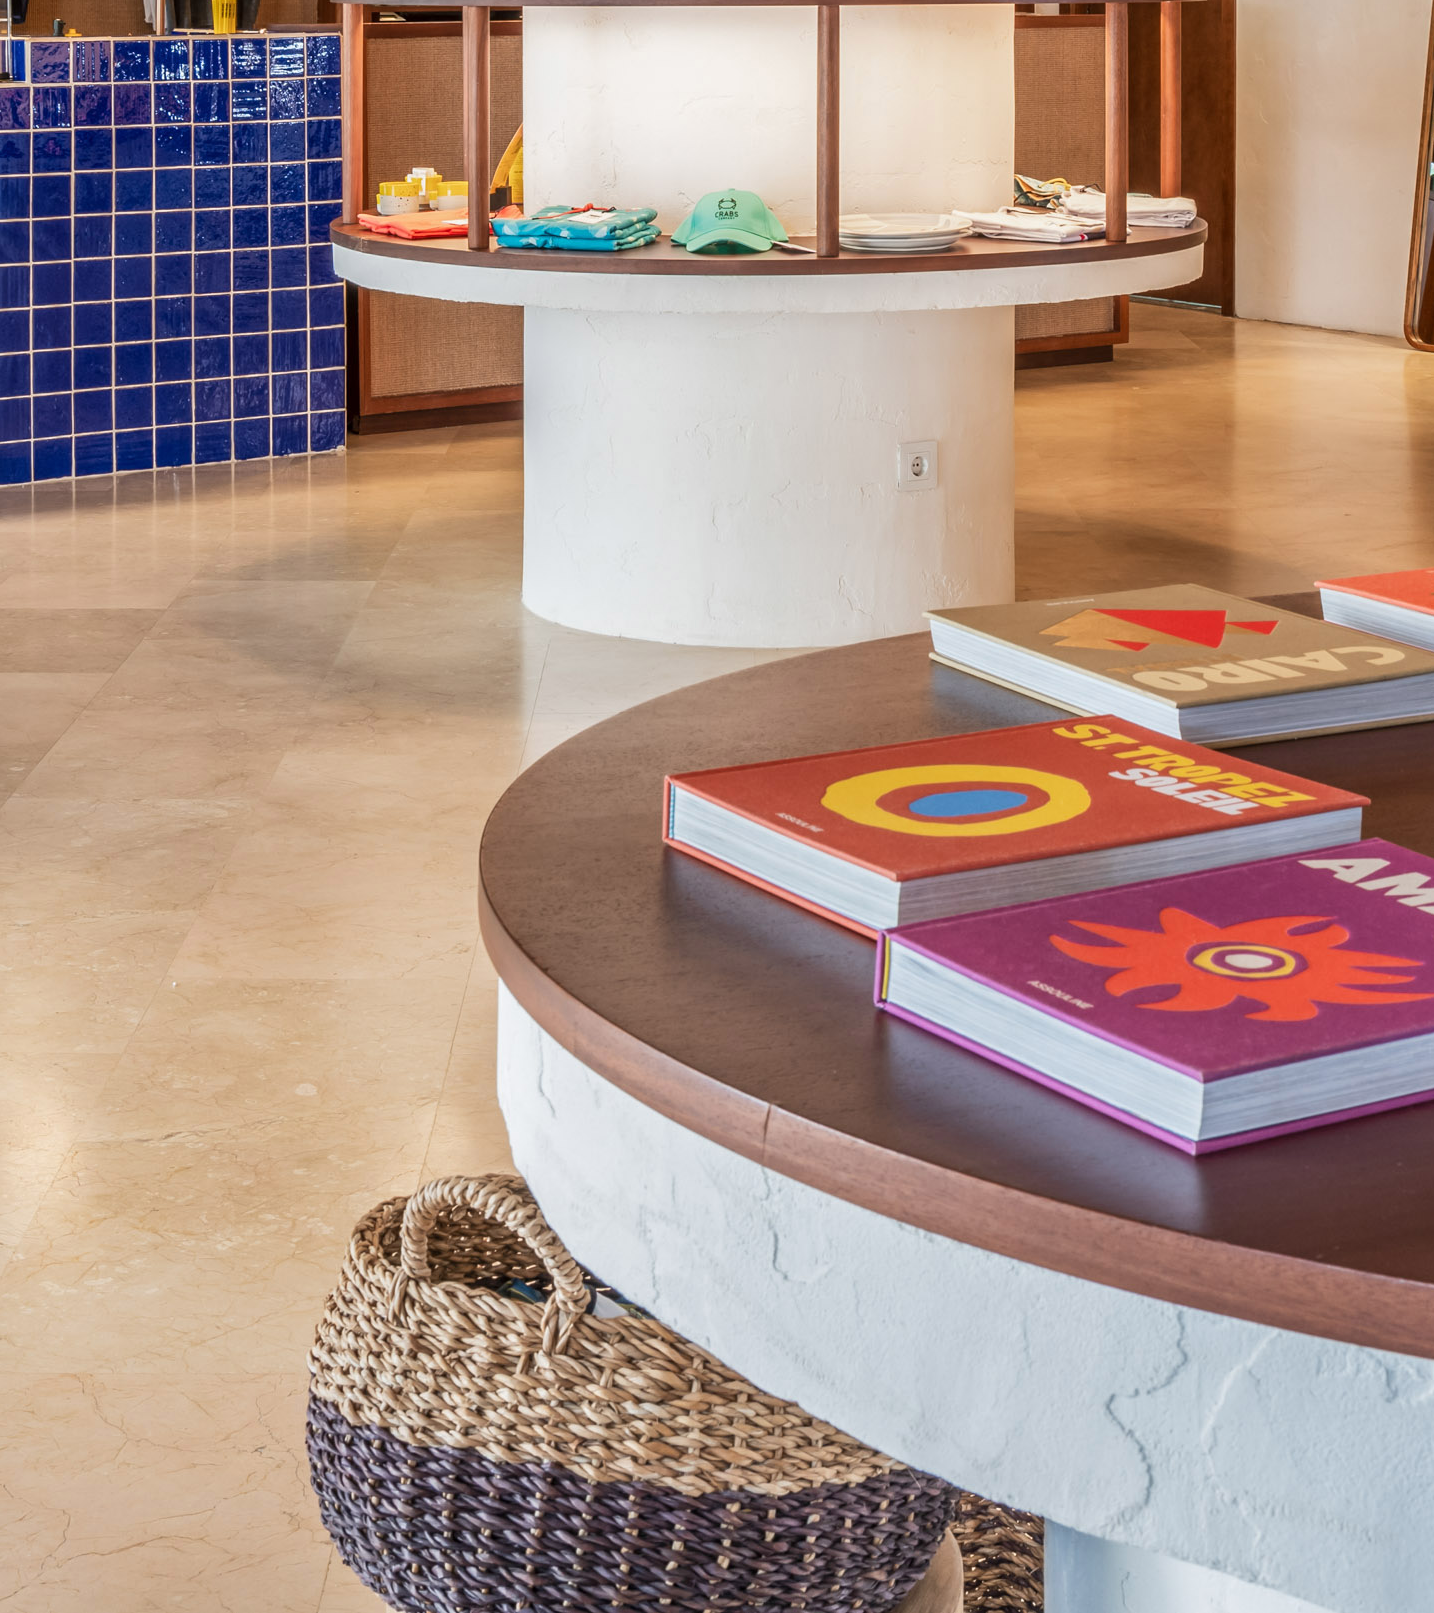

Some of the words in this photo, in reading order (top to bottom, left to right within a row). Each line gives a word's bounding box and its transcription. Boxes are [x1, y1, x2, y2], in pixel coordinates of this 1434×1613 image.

[1132, 646, 1406, 691] CAIRO
[1052, 723, 1114, 752] ST.
[1123, 744, 1318, 809] TROPEZ
[1107, 767, 1261, 817] SOLEIL
